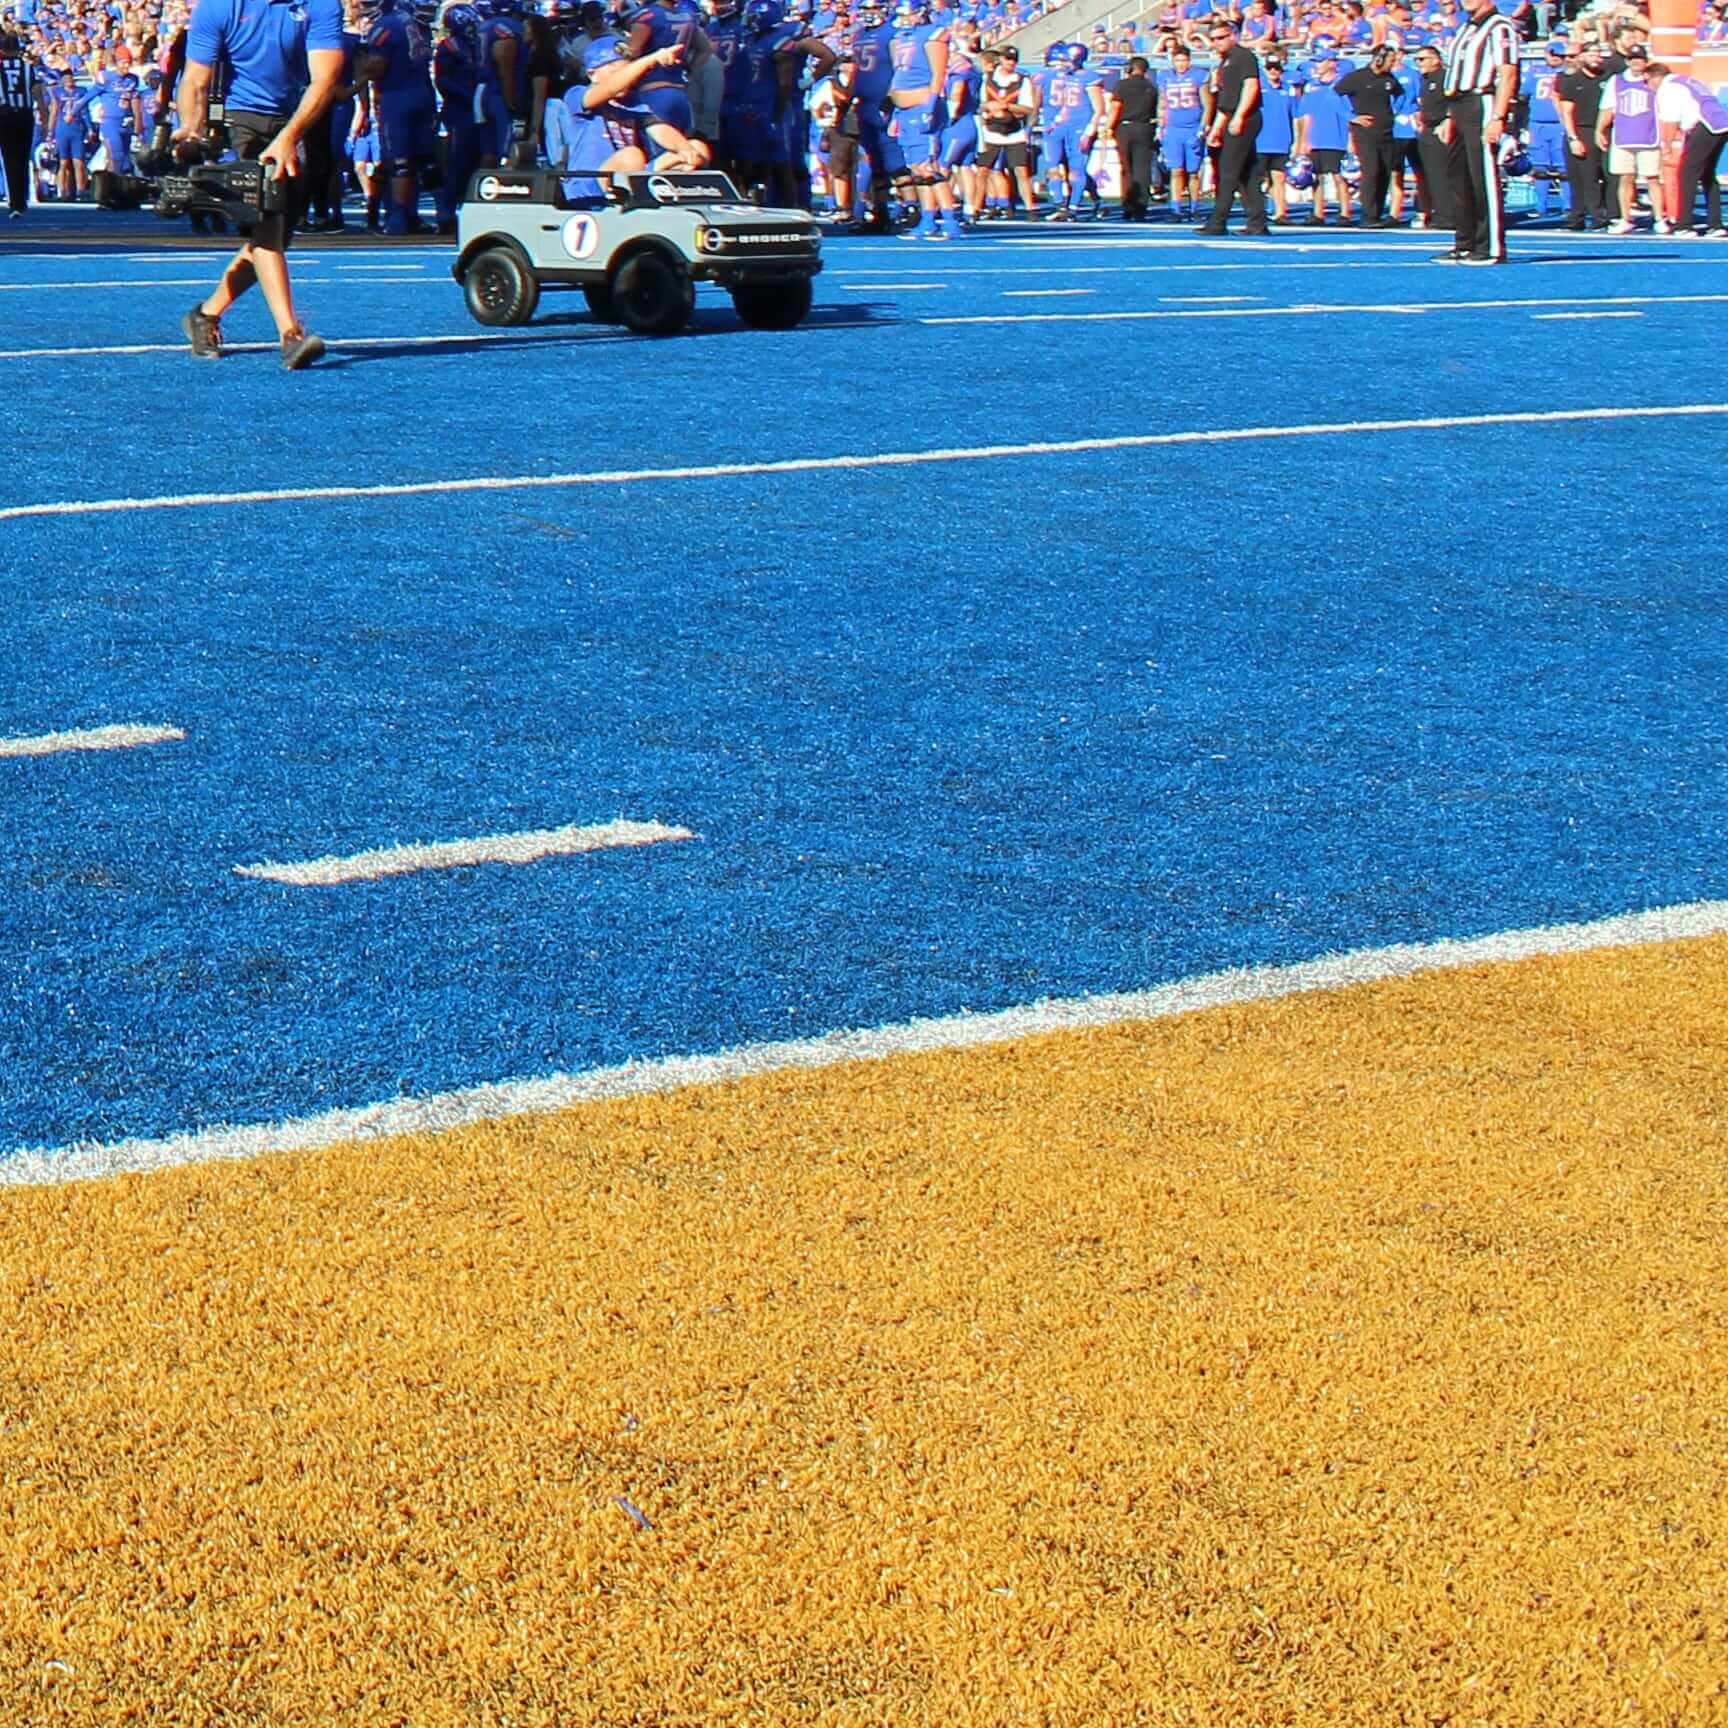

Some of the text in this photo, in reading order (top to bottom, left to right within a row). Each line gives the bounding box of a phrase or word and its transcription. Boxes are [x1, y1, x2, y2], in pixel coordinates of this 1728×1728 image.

[5, 69, 21, 92] F
[1166, 85, 1198, 109] 55
[576, 222, 588, 252] 1
[739, 233, 800, 244] BRONCO
